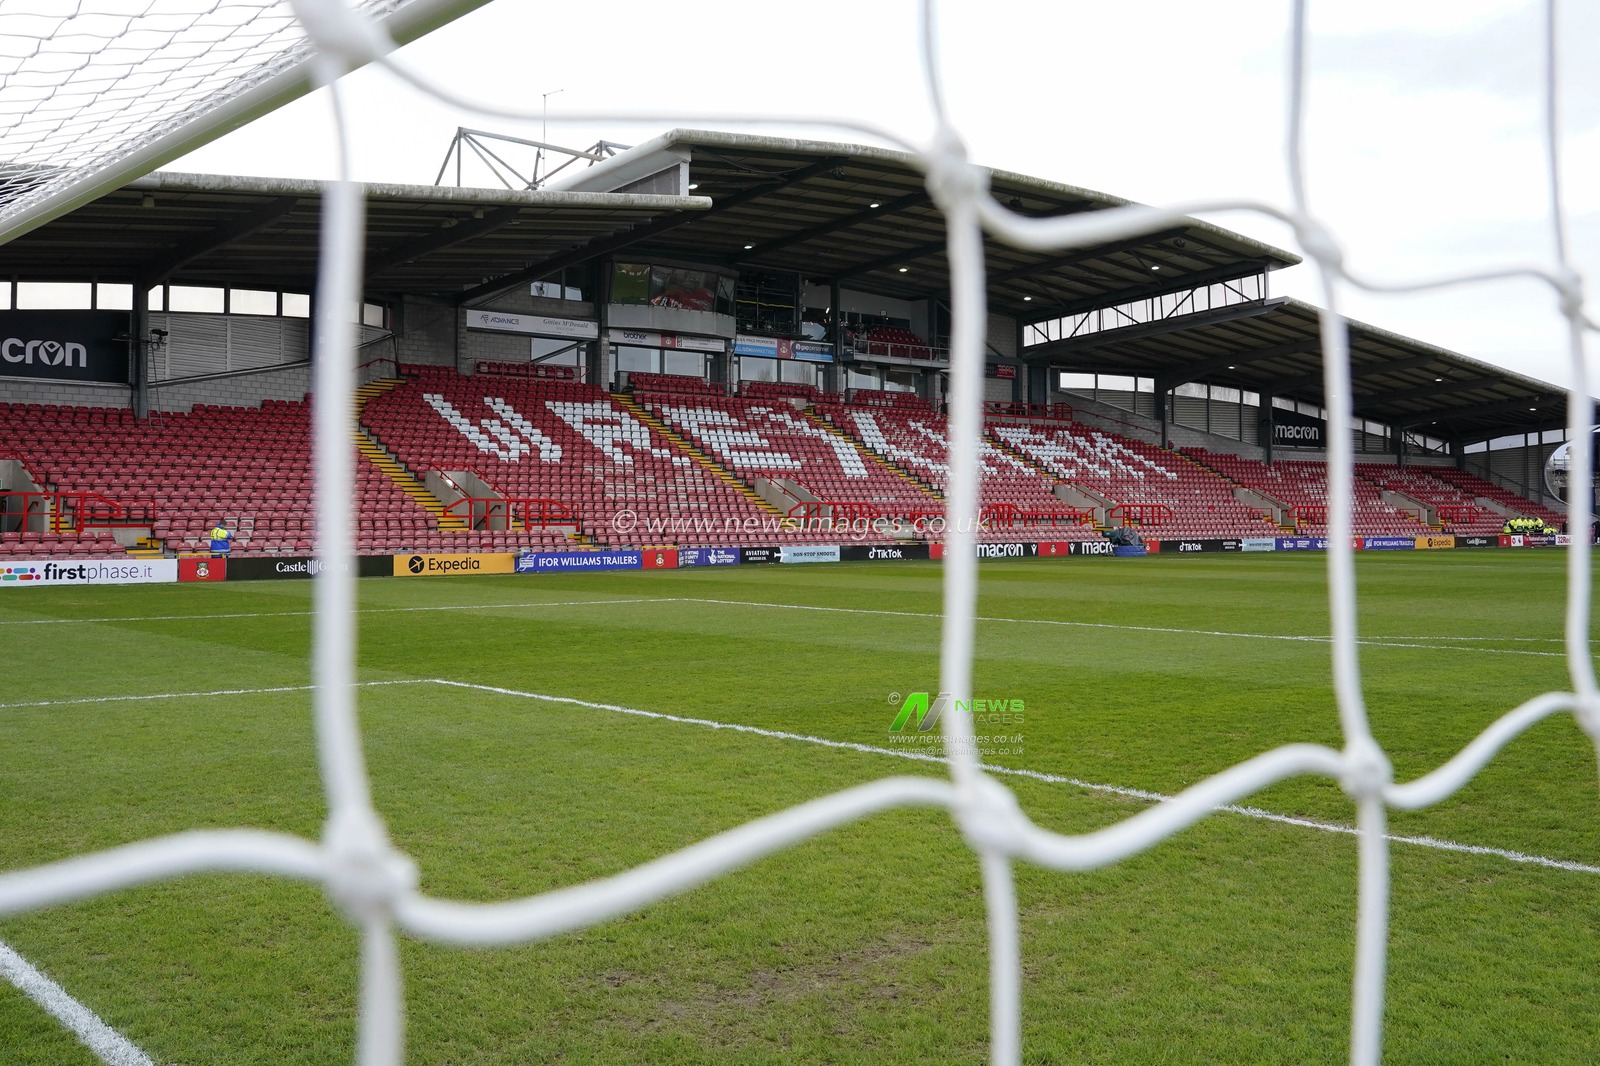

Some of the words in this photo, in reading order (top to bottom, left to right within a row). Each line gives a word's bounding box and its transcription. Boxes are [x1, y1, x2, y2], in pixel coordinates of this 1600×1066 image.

[623, 331, 647, 340] brother
[0, 337, 87, 368] cron
[1275, 424, 1319, 440] macron
[1184, 543, 1202, 551] TikTok
[1433, 538, 1451, 547] Expedia
[876, 549, 902, 559] TikTok
[976, 543, 1024, 557] macron
[275, 561, 307, 572] Castle
[428, 557, 480, 573] Expedia
[538, 558, 559, 567] IFOR
[560, 556, 601, 566] WILLIAMS
[602, 555, 638, 565] TRAILERS
[44, 562, 153, 583] firstphase.it
